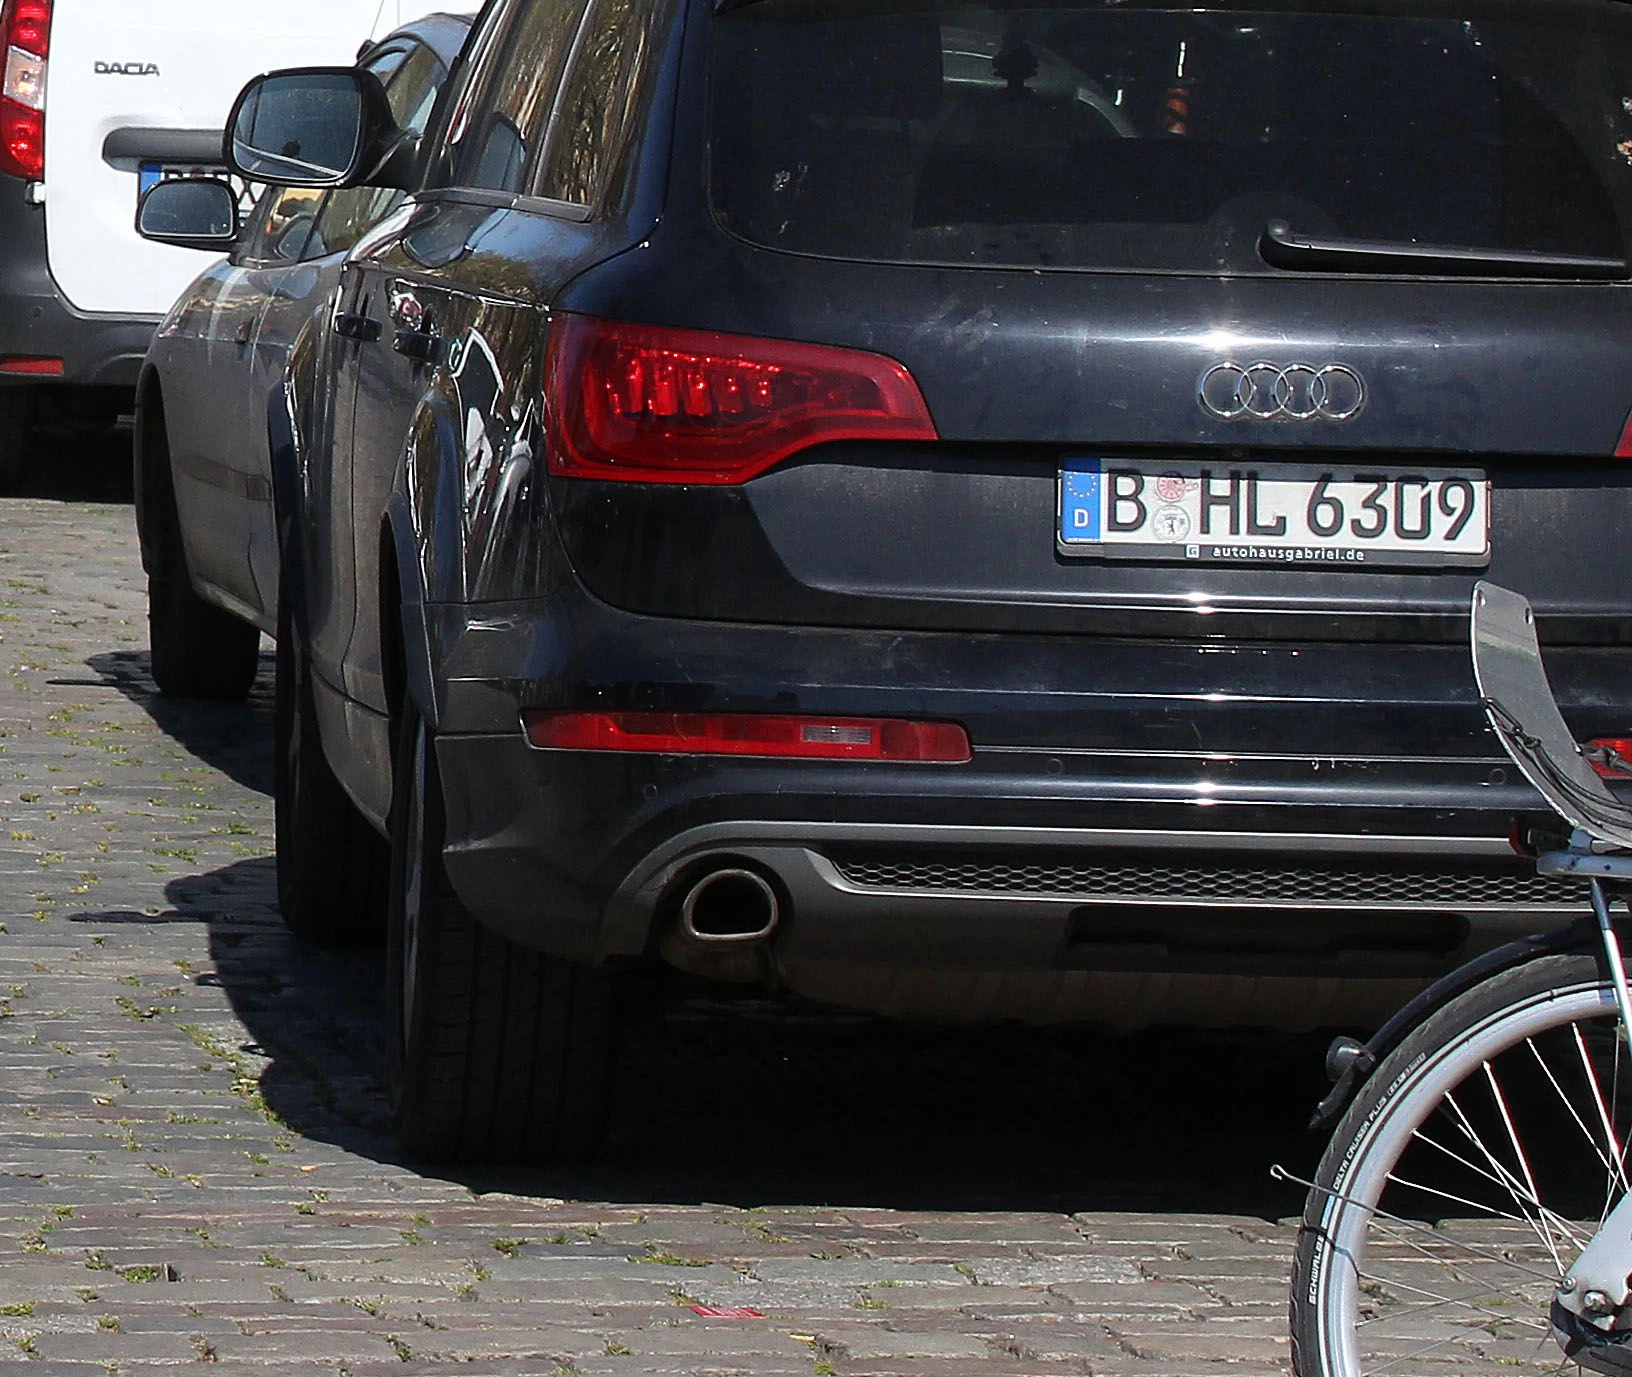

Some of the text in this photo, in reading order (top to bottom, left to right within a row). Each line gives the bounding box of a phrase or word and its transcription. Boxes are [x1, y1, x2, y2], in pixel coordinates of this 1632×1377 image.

[95, 61, 160, 76] DACIA
[1107, 469, 1475, 541] B HL 6309
[1074, 509, 1089, 527] D
[1212, 545, 1365, 562] autohausgabriel.de
